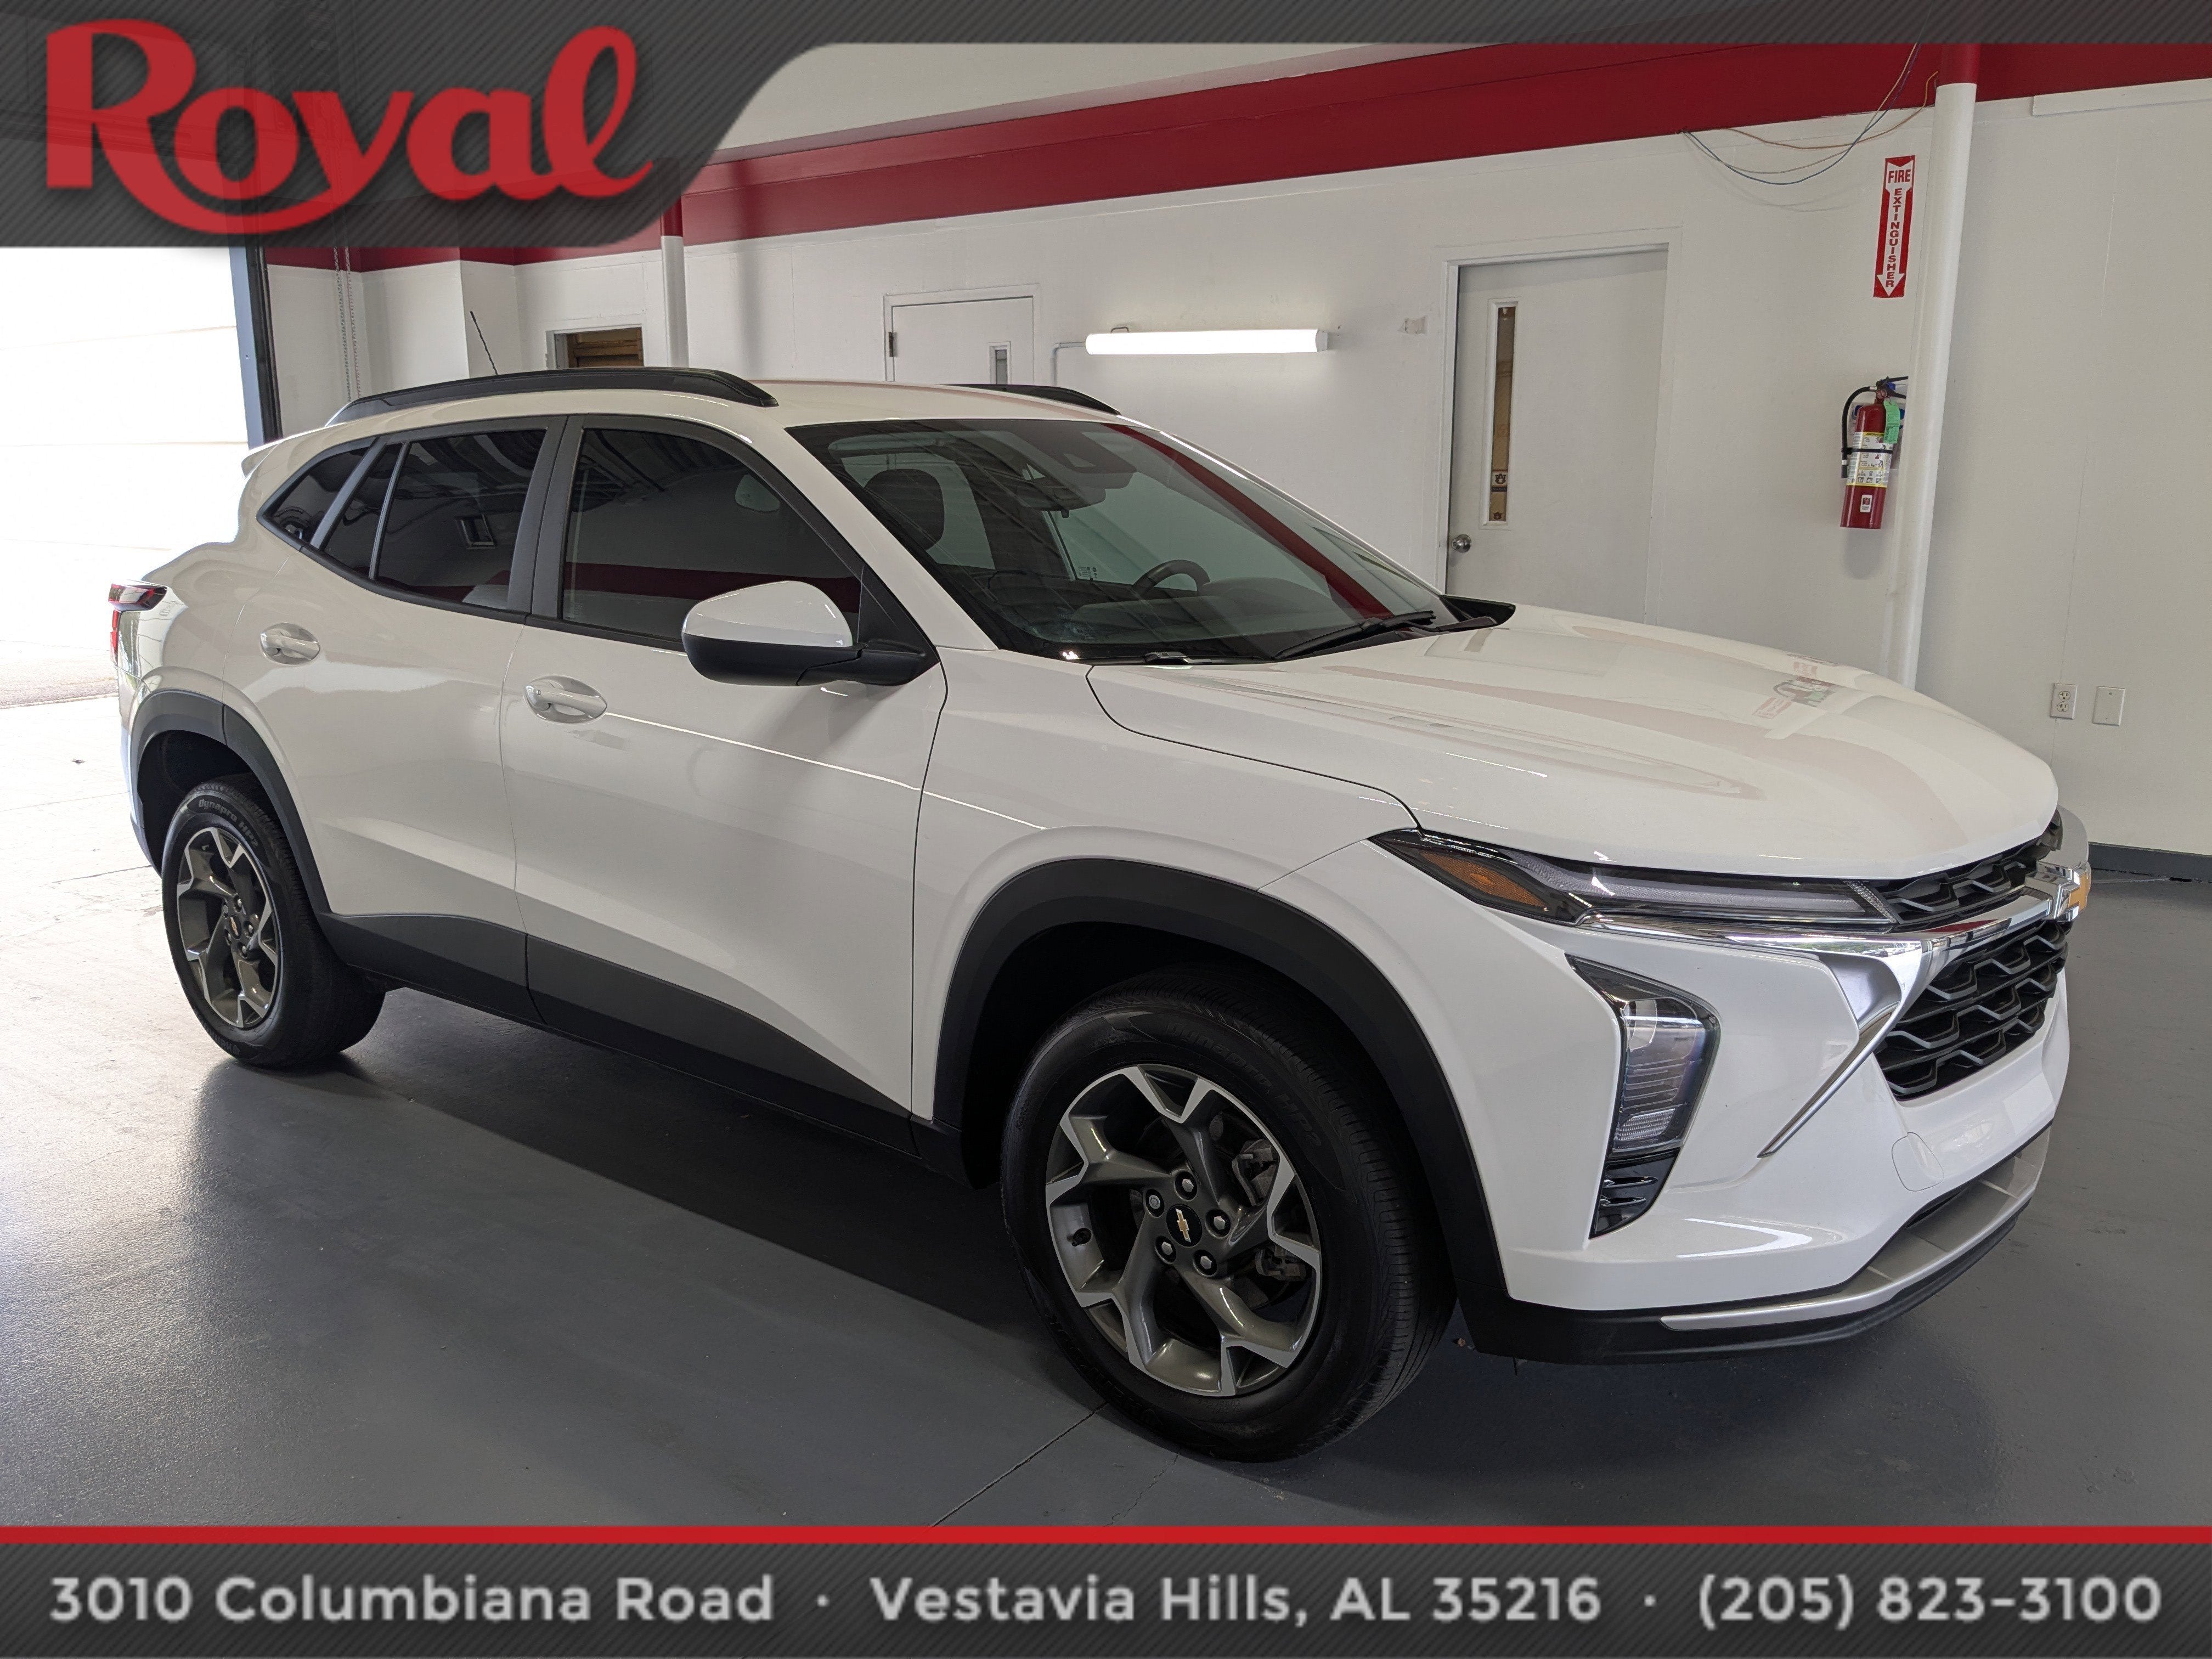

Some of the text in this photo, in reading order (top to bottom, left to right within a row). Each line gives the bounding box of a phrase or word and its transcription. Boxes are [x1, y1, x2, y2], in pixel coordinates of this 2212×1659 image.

[1888, 169, 1911, 184] FIRE
[1885, 188, 1903, 287] EXTINGUISHER
[198, 799, 238, 822] Dynapro
[1165, 1022, 1322, 1147] Dynapro HP2
